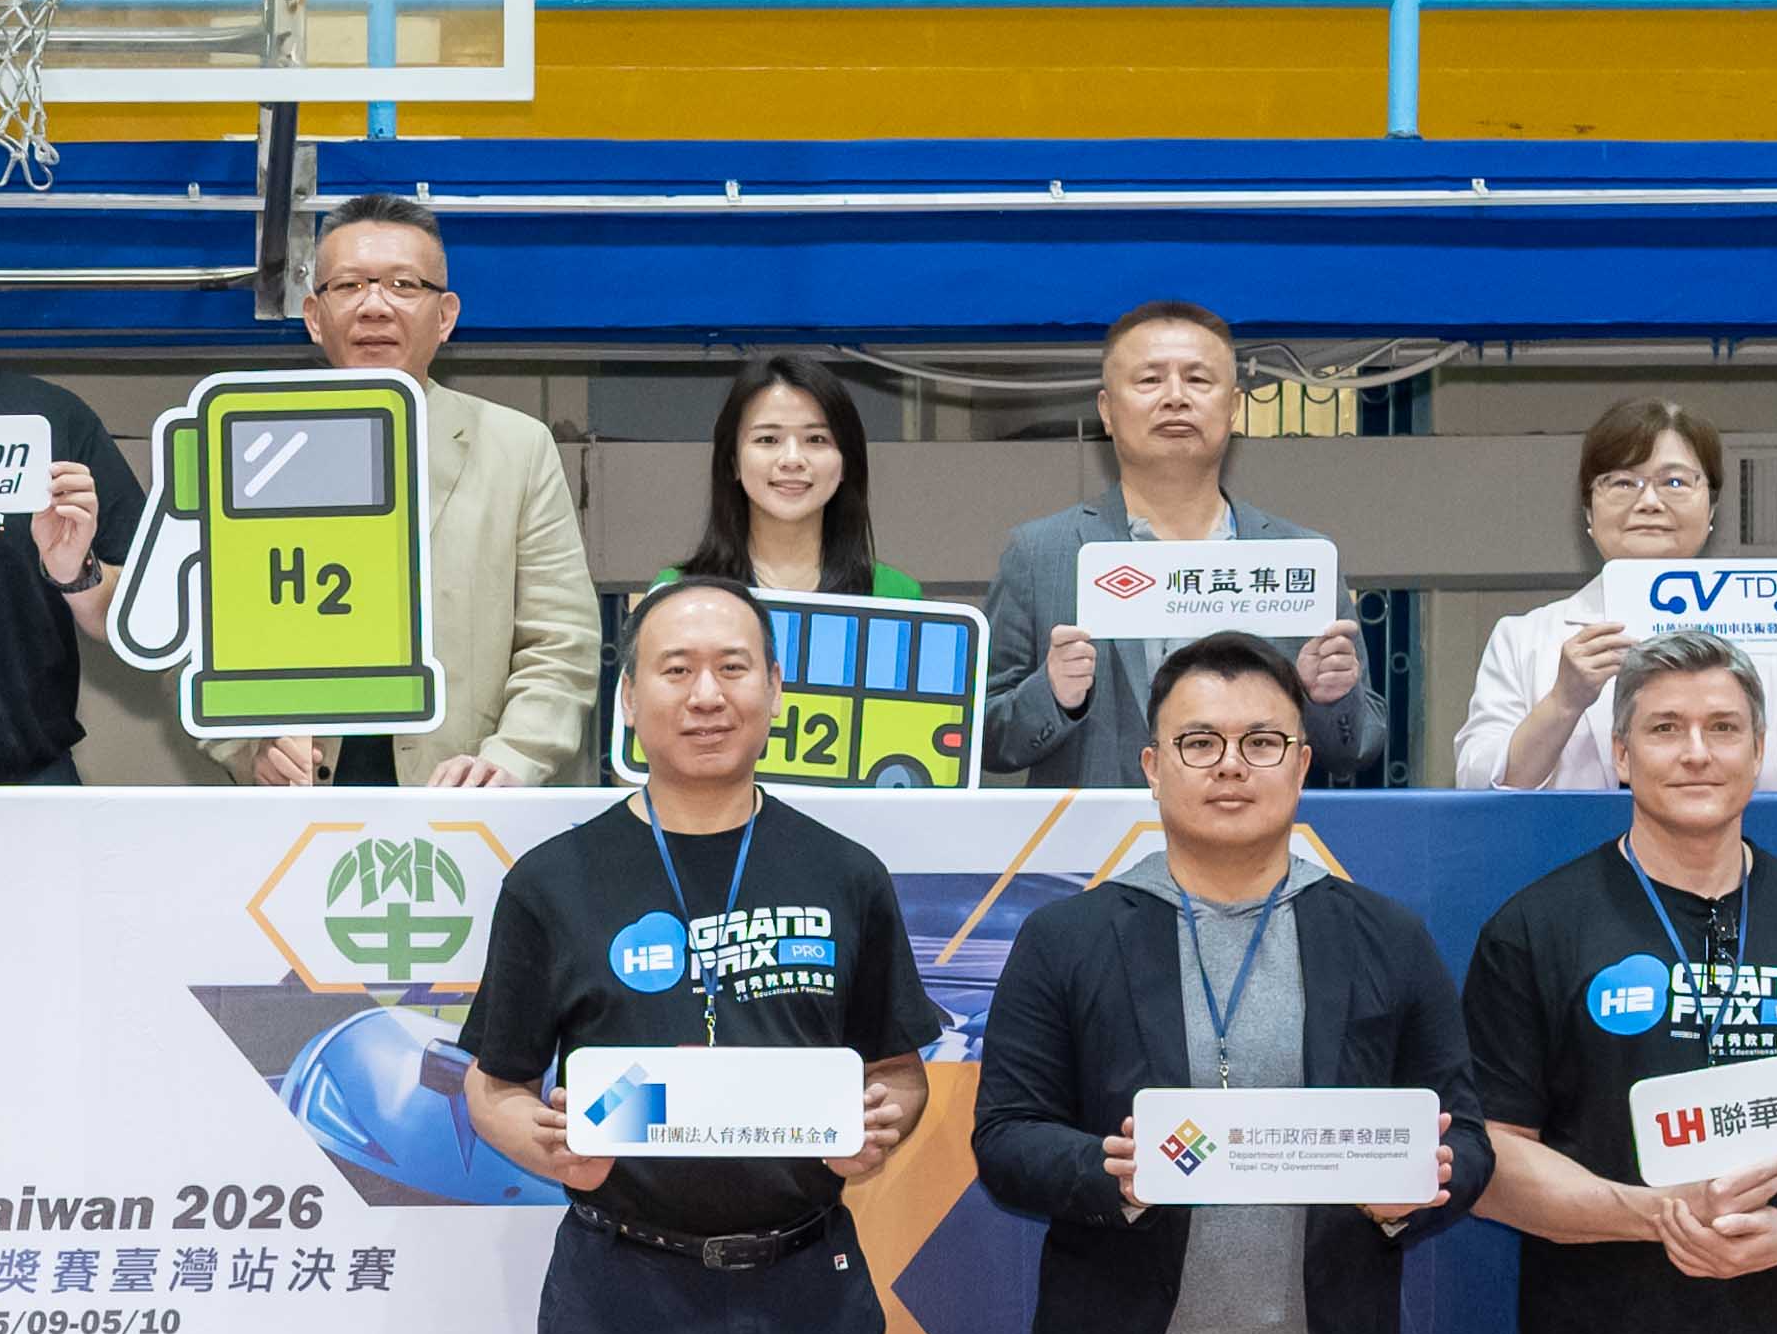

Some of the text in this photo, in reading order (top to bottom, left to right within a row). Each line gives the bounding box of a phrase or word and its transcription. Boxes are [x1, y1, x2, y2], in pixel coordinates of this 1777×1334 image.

[270, 547, 352, 616] H2
[1166, 567, 1315, 595] 順益集團
[1166, 599, 1315, 613] SHUNG YE GROUP
[758, 705, 839, 765] H2
[689, 906, 831, 951] GRAND
[623, 944, 674, 975] H2
[690, 938, 826, 980] PRIX PRO
[1600, 986, 1654, 1017] H2
[649, 1124, 838, 1146] 財團法人育秀教育基金會
[1228, 1127, 1411, 1145] 臺北市政府產業發展局
[171, 1184, 324, 1231] 2026
